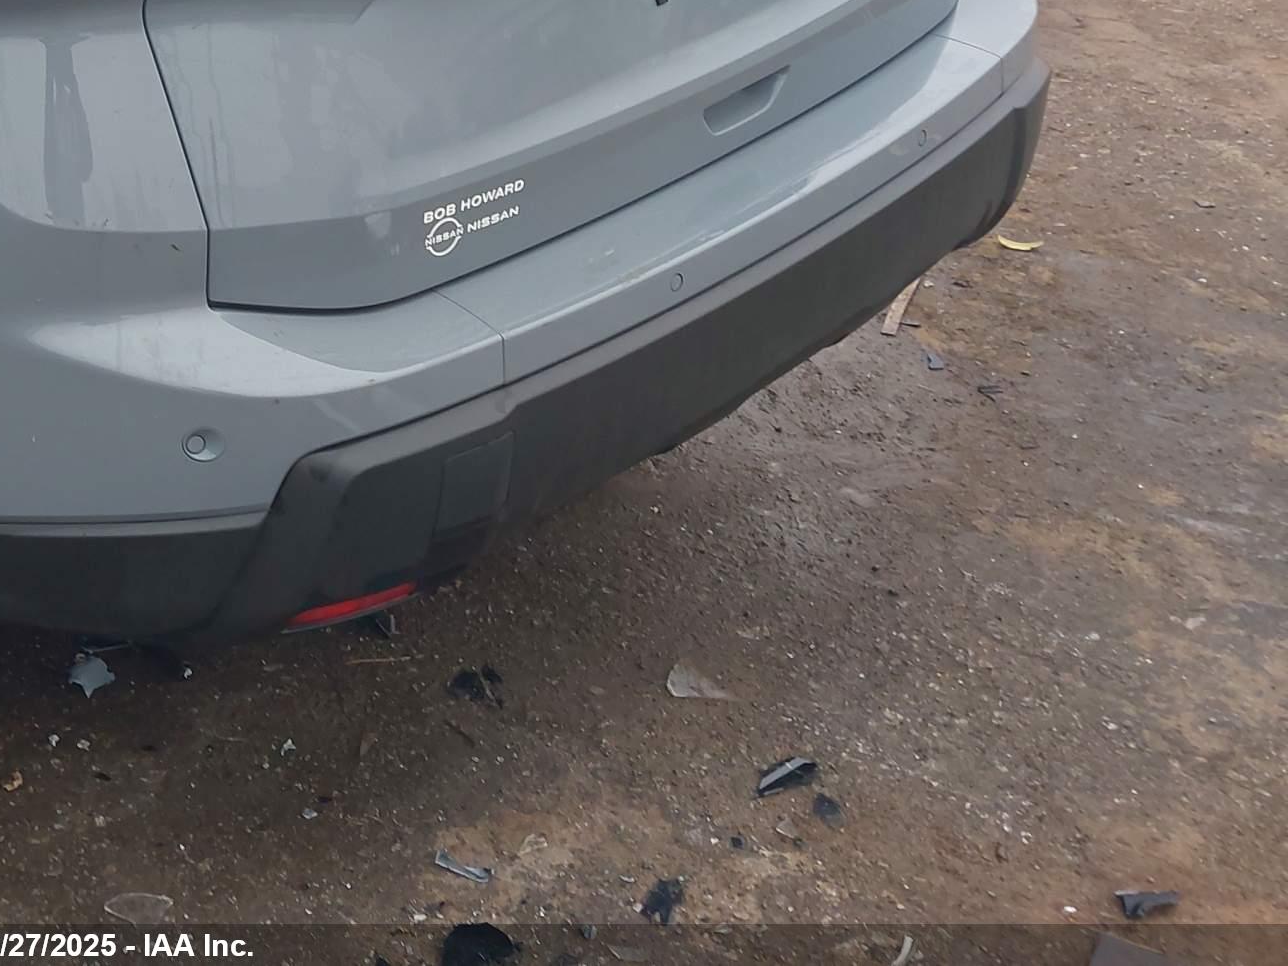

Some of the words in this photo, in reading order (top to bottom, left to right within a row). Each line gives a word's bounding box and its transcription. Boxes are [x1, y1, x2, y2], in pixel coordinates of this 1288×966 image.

[423, 203, 457, 224] BOB
[460, 179, 525, 212] HOWARD
[467, 205, 520, 233] NISSAN
[424, 226, 464, 247] NISSAN
